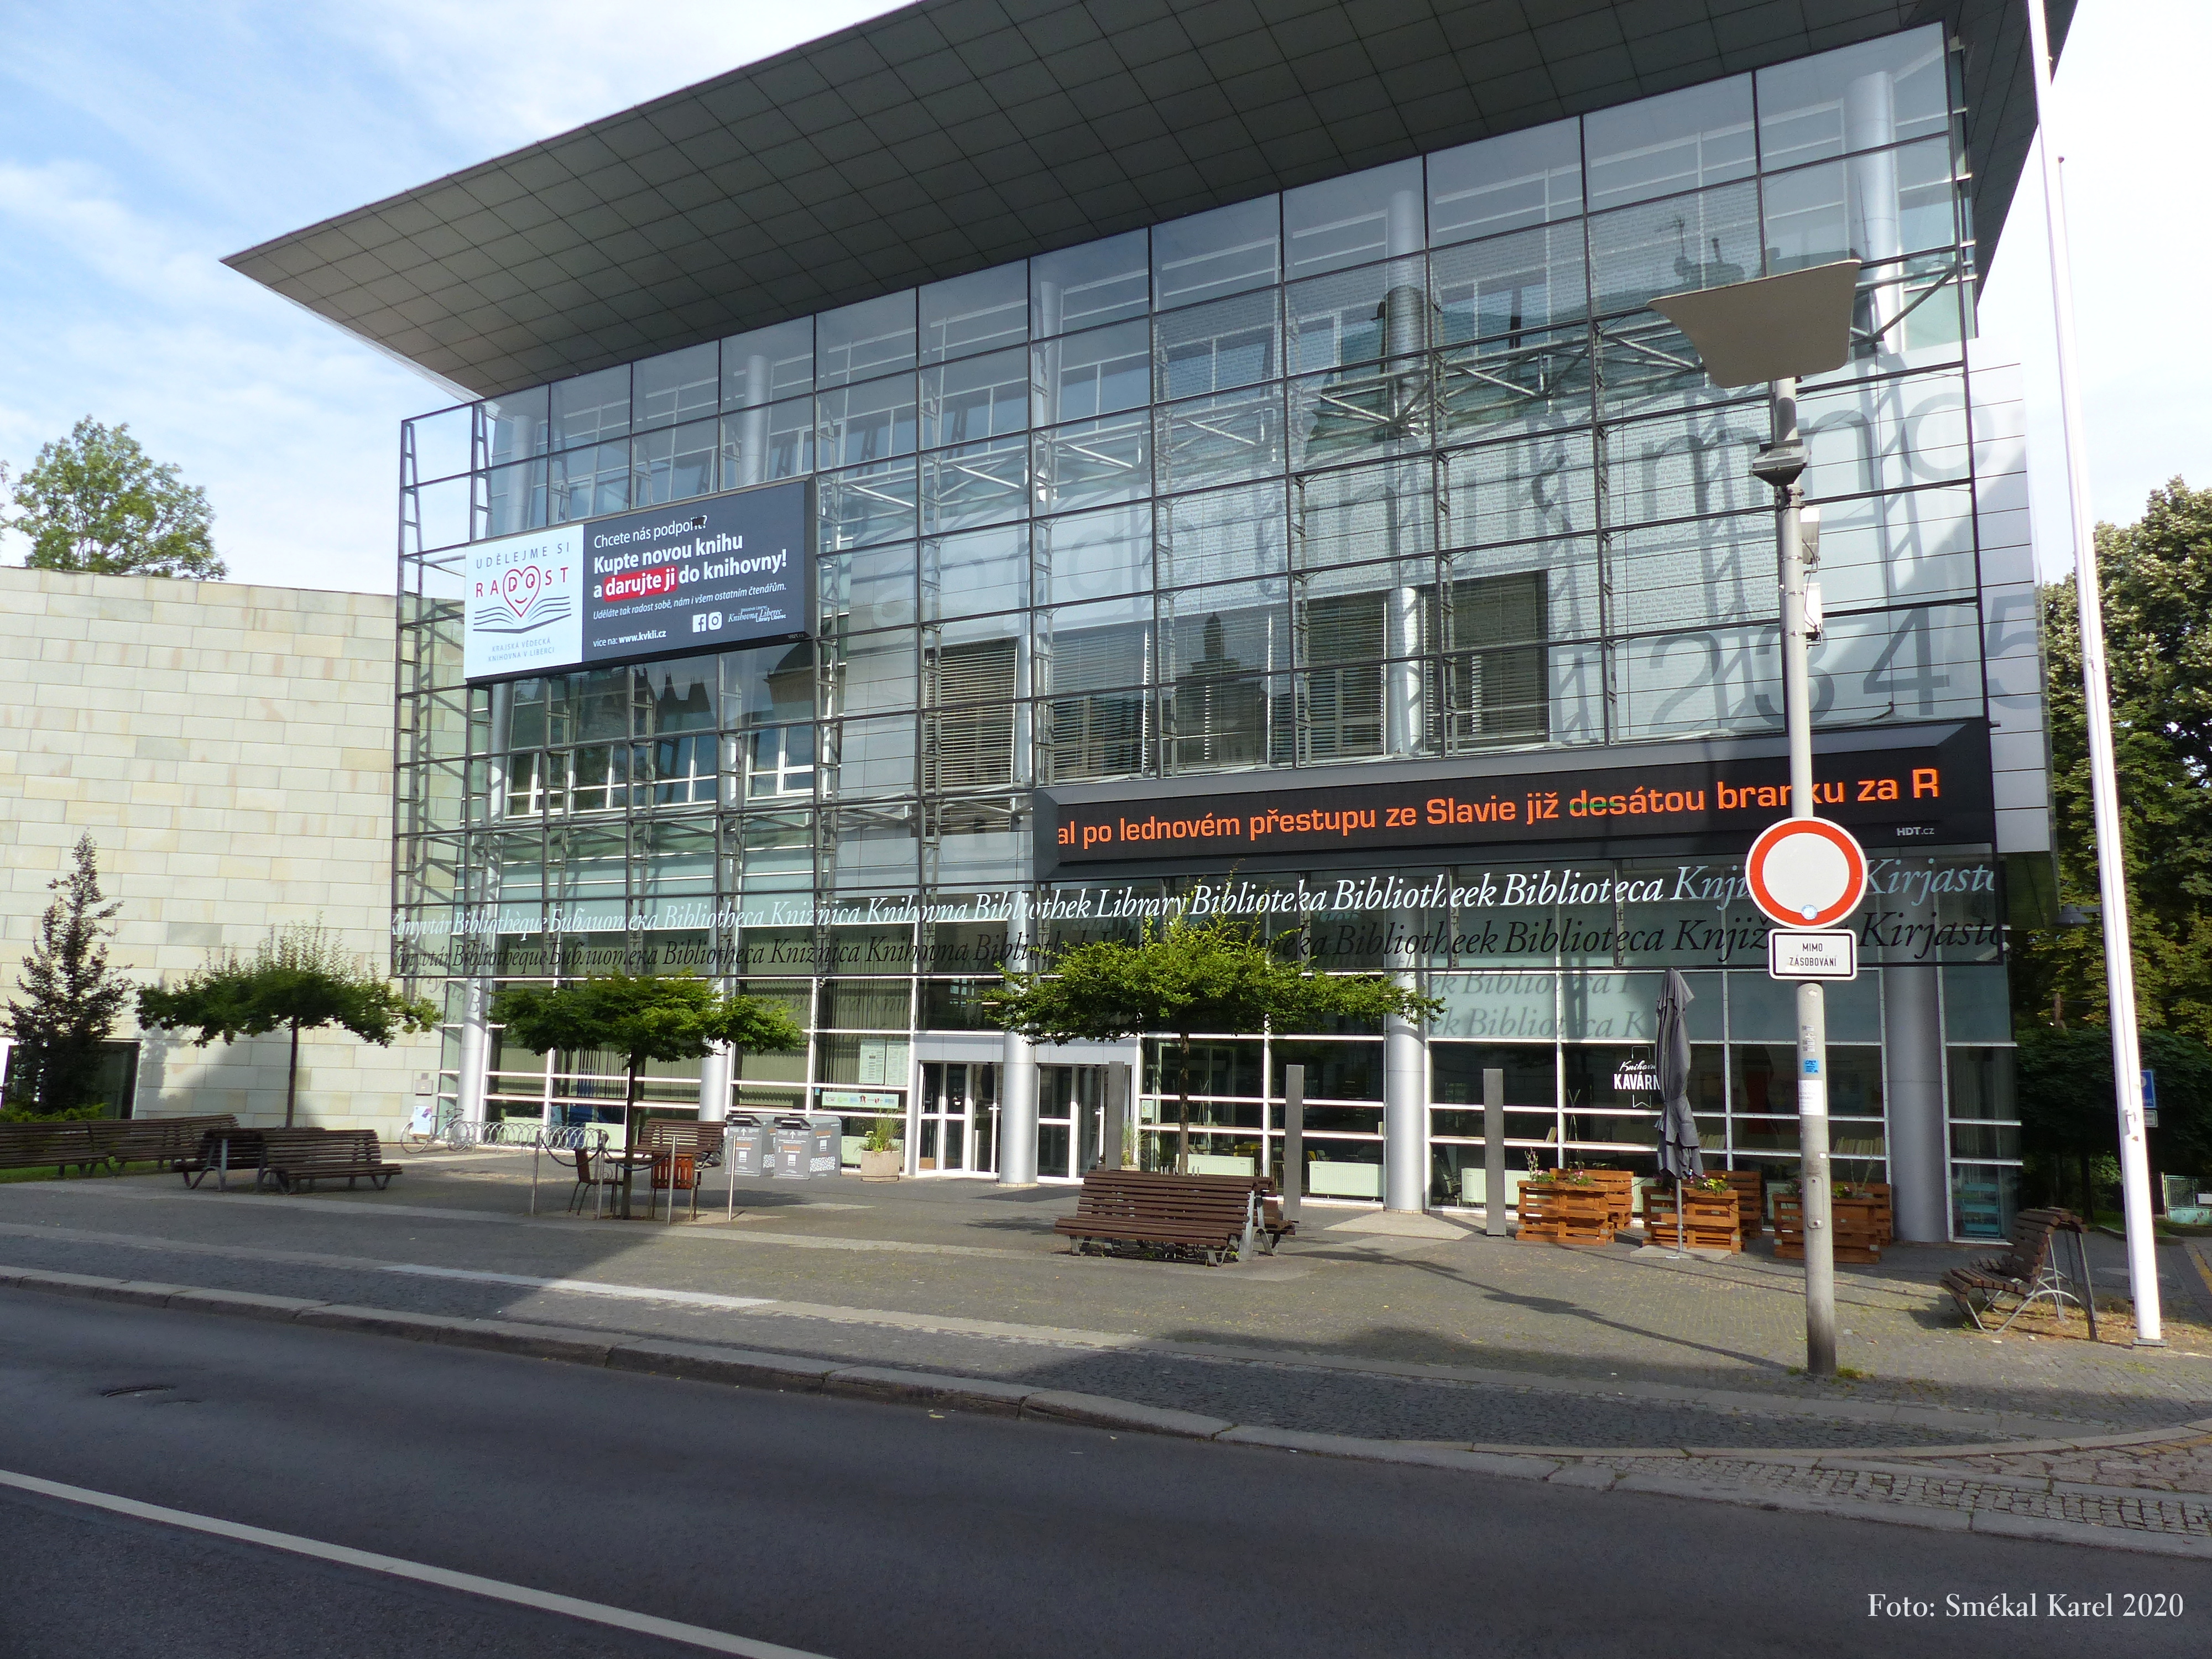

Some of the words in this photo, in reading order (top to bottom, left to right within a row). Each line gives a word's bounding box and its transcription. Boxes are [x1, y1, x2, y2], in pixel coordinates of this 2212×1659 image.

[594, 532, 630, 549] Chcete
[633, 526, 651, 541] nás
[477, 546, 547, 568] UDĚLEJME
[557, 542, 569, 554] SI
[594, 552, 639, 575] Kupte
[643, 544, 692, 566] novou
[696, 533, 743, 556] knihu
[476, 567, 568, 597] RADOST
[593, 584, 602, 598] a
[606, 572, 661, 596] darujte
[664, 567, 675, 592] ji
[679, 565, 700, 584] do
[703, 549, 787, 581] knihovny!
[593, 610, 618, 620] Uděláte
[620, 606, 630, 615] tak
[632, 603, 654, 613] radost
[655, 600, 672, 610] sobě,
[674, 597, 690, 607] nám
[691, 596, 693, 604] i
[695, 594, 713, 604] všem
[714, 588, 747, 601] ostatním
[748, 582, 786, 596] čtenářům.
[492, 641, 519, 652] KRAJSKÁ
[593, 638, 606, 647] více
[619, 630, 667, 643] www.kvkli.cz
[488, 651, 521, 662] KNIHOVNA
[530, 646, 555, 656] LIBERCI
[1058, 820, 1075, 844] al
[1083, 825, 1112, 849] po
[1120, 812, 1240, 841] lednovém
[1250, 809, 1376, 841] přestupu
[1386, 805, 1417, 827] ze
[1427, 795, 1516, 825] Slavie
[1526, 793, 1559, 825] již
[1570, 786, 1705, 817] desátou
[1858, 778, 1898, 802] za
[1912, 768, 1939, 798] R
[1896, 826, 1934, 836] HDT.cz
[664, 901, 764, 929] Bibliotheca
[861, 895, 968, 923] Knihovna
[972, 888, 1092, 921] Bibliothek
[1094, 886, 1187, 926] Library
[1190, 879, 1327, 915] Biblioteka
[1331, 872, 1496, 911] Bibliotheek
[1500, 869, 1664, 907] Biblioteca
[453, 909, 547, 941] Bibliothèque
[662, 938, 765, 966] Bibliotheca
[865, 934, 968, 963] Knihovna
[1332, 920, 1496, 956] Bibliotheek
[1503, 917, 1665, 954] Biblioteca
[1802, 943, 1823, 952] MIMO
[1789, 954, 1837, 967] ZÁSOBOVÁNÍ
[1614, 1071, 1661, 1090] KAVÁRN
